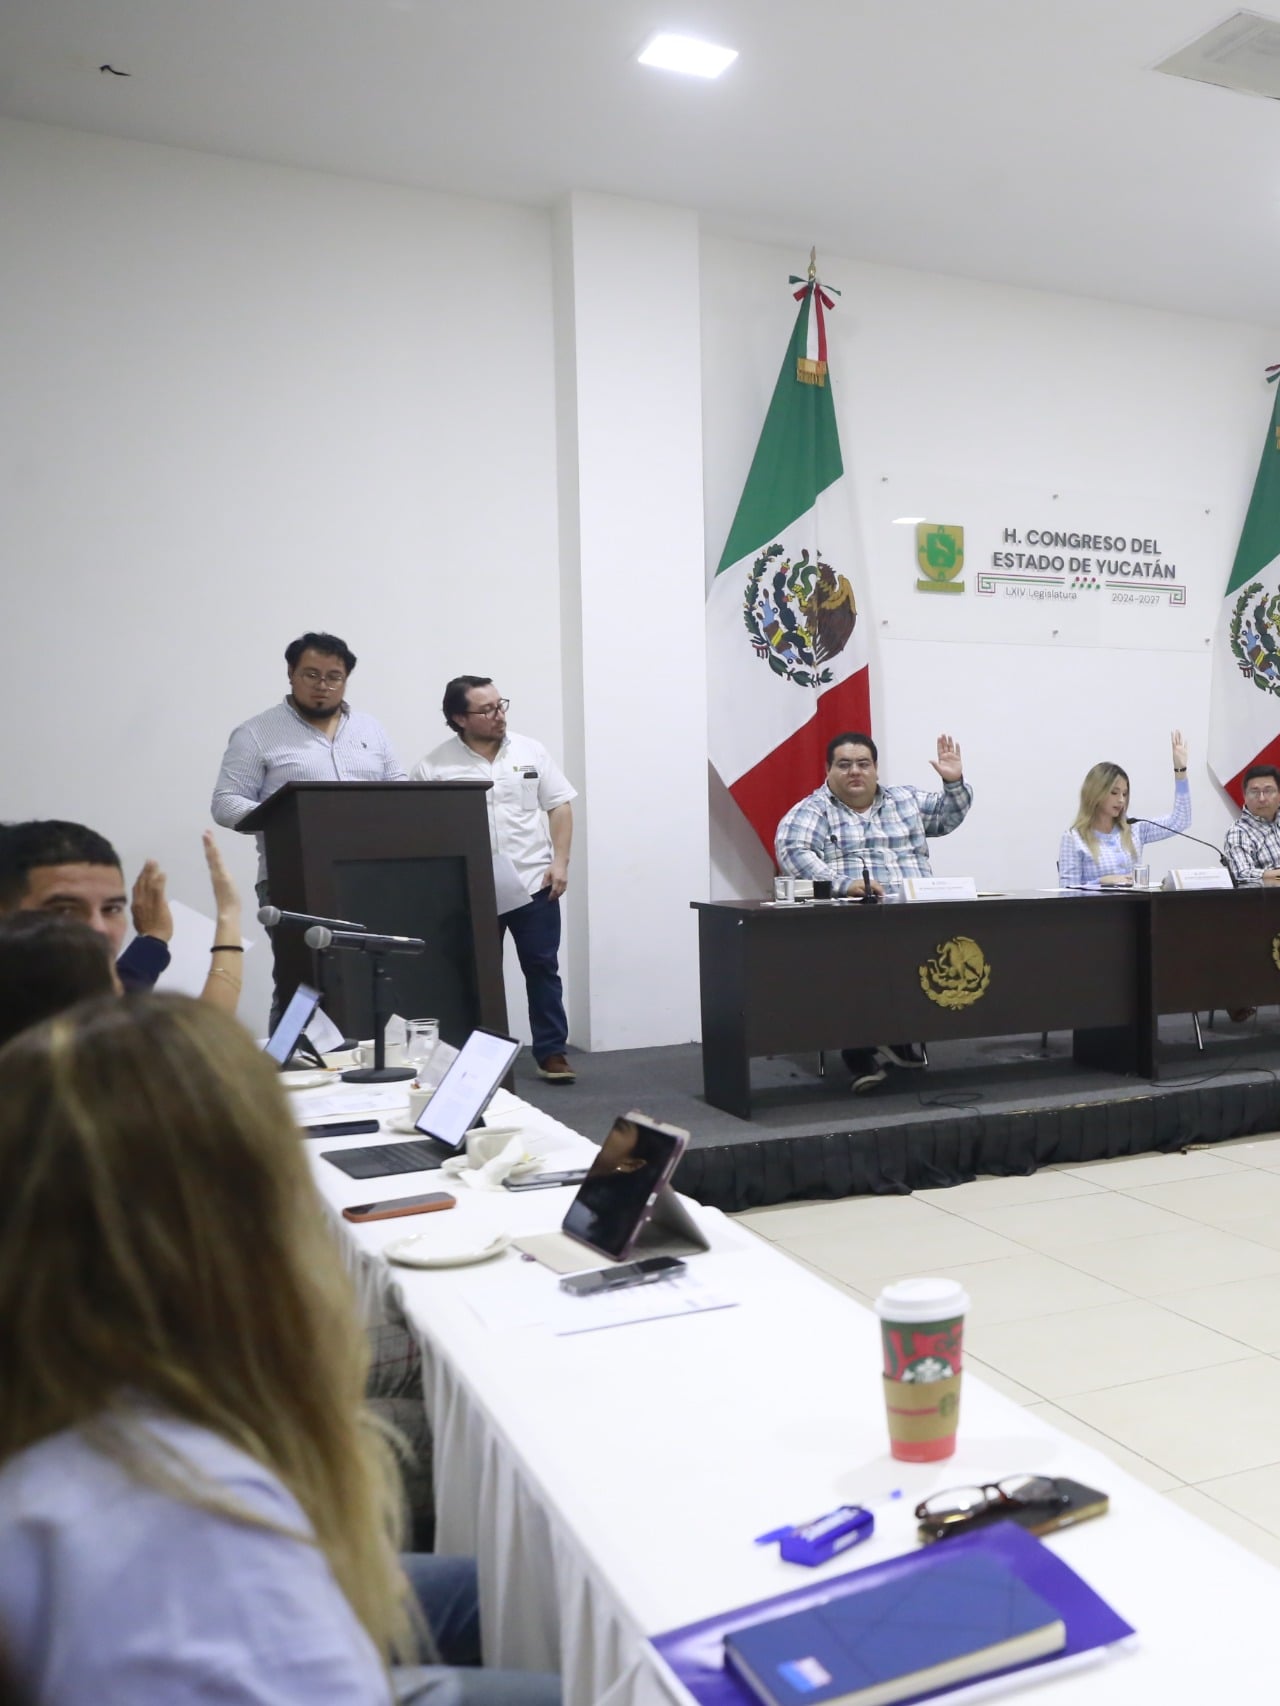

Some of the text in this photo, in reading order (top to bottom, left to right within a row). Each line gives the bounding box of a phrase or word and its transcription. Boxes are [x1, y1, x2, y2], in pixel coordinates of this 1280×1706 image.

[1004, 528, 1162, 554] H. CONGRESO DEL
[993, 552, 1175, 579] ESTADO DE YUCATÁN
[1005, 586, 1077, 600] LXIV Legislatura
[1112, 592, 1160, 604] 2024-2027
